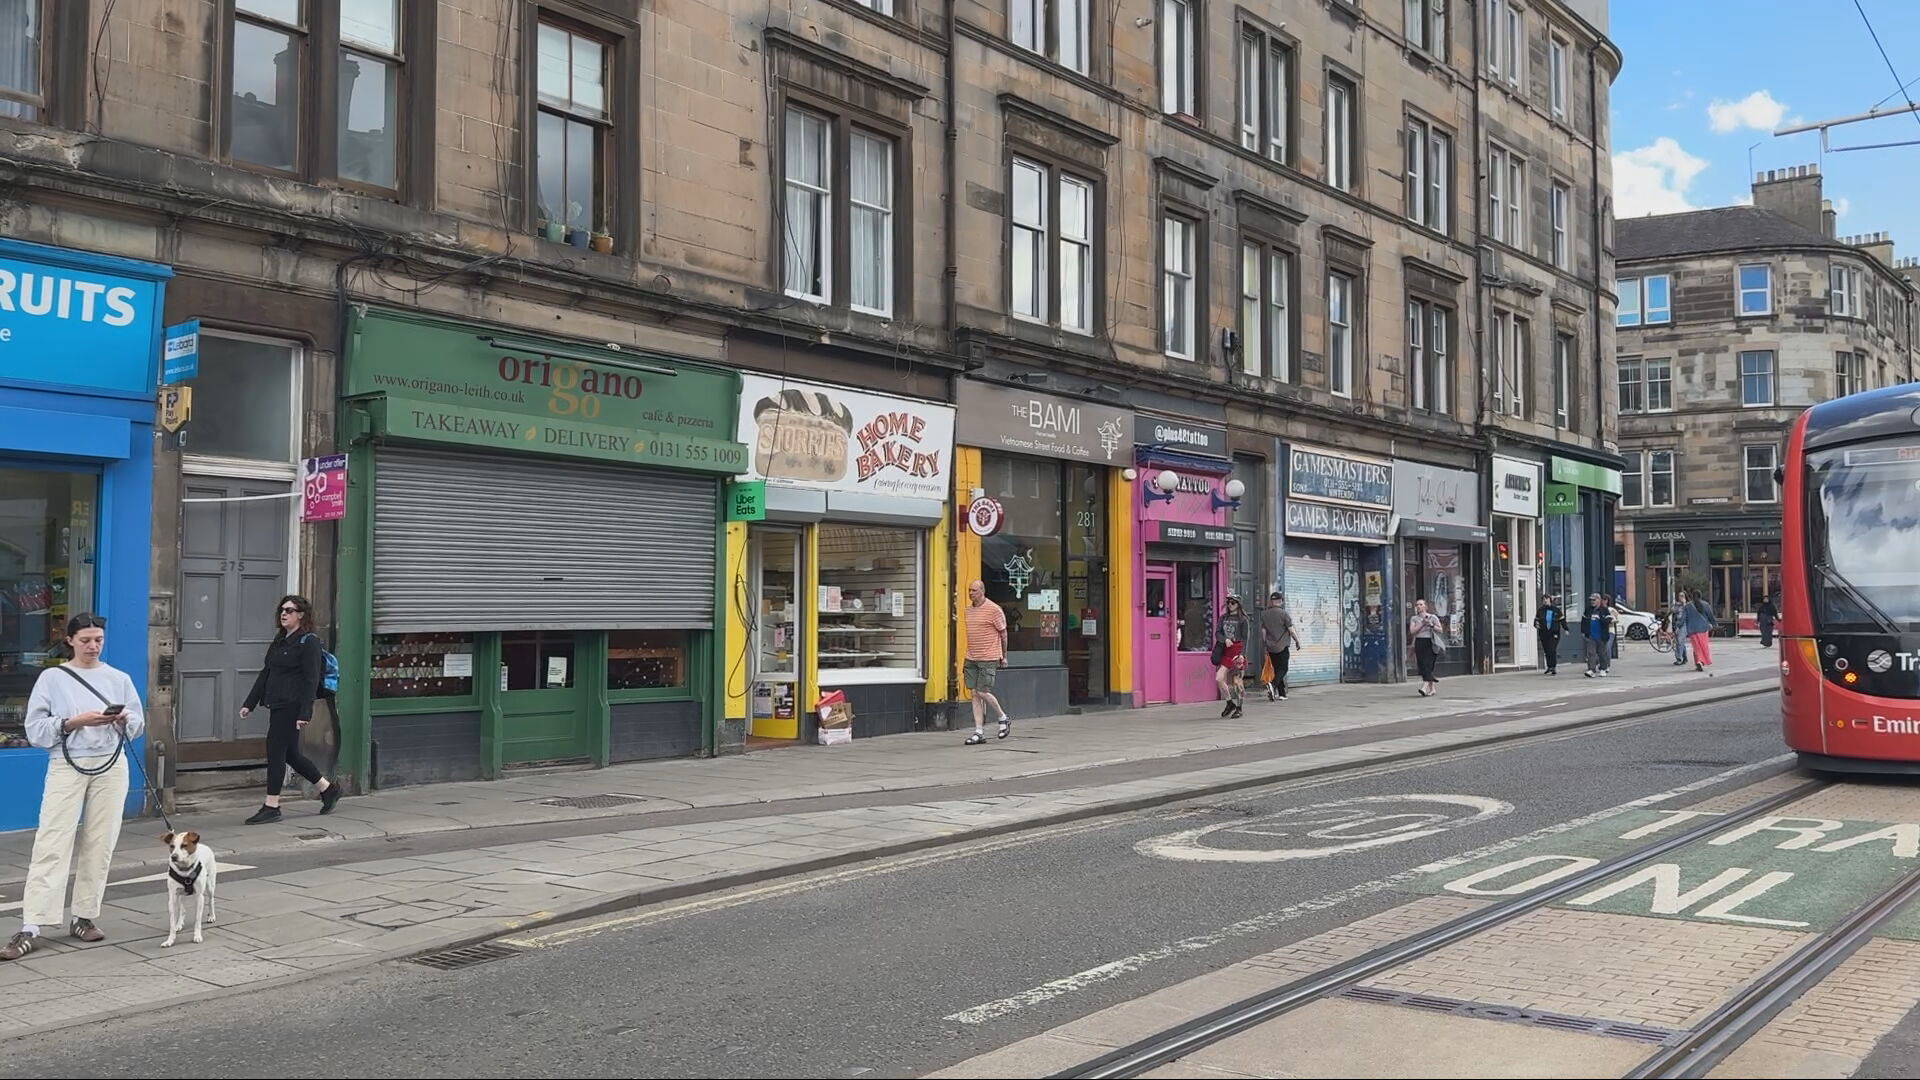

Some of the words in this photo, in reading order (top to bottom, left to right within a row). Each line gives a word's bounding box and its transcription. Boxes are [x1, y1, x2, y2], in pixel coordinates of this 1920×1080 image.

[373, 374, 526, 404] www.origano-leith.co.uk
[498, 354, 643, 416] origano
[666, 414, 675, 425] &
[677, 414, 714, 430] pizzeria
[857, 411, 927, 449] HOME
[1012, 404, 1028, 418] THE
[1029, 400, 1080, 435] BAMI
[411, 411, 520, 440] TAKEAWAY
[544, 427, 630, 453] DELIVERY
[649, 440, 681, 459] 0131
[684, 443, 709, 461] 555
[713, 446, 742, 464] 1009
[760, 424, 845, 460] STORRIES
[1000, 434, 1034, 449] Vietnamese
[1034, 440, 1050, 451] Street
[1051, 442, 1065, 454] Food
[1072, 445, 1090, 457] Coffee
[857, 440, 940, 483] BAKERY
[736, 494, 755, 505] Uber
[736, 505, 756, 515] Eats
[1077, 511, 1096, 528] 281
[1288, 505, 1329, 530] GAMES
[1333, 510, 1386, 535] EXCHANGE
[1649, 532, 1661, 540] LA
[1662, 532, 1686, 540] CASA
[220, 561, 246, 572] 275
[1895, 649, 1920, 672] Tr
